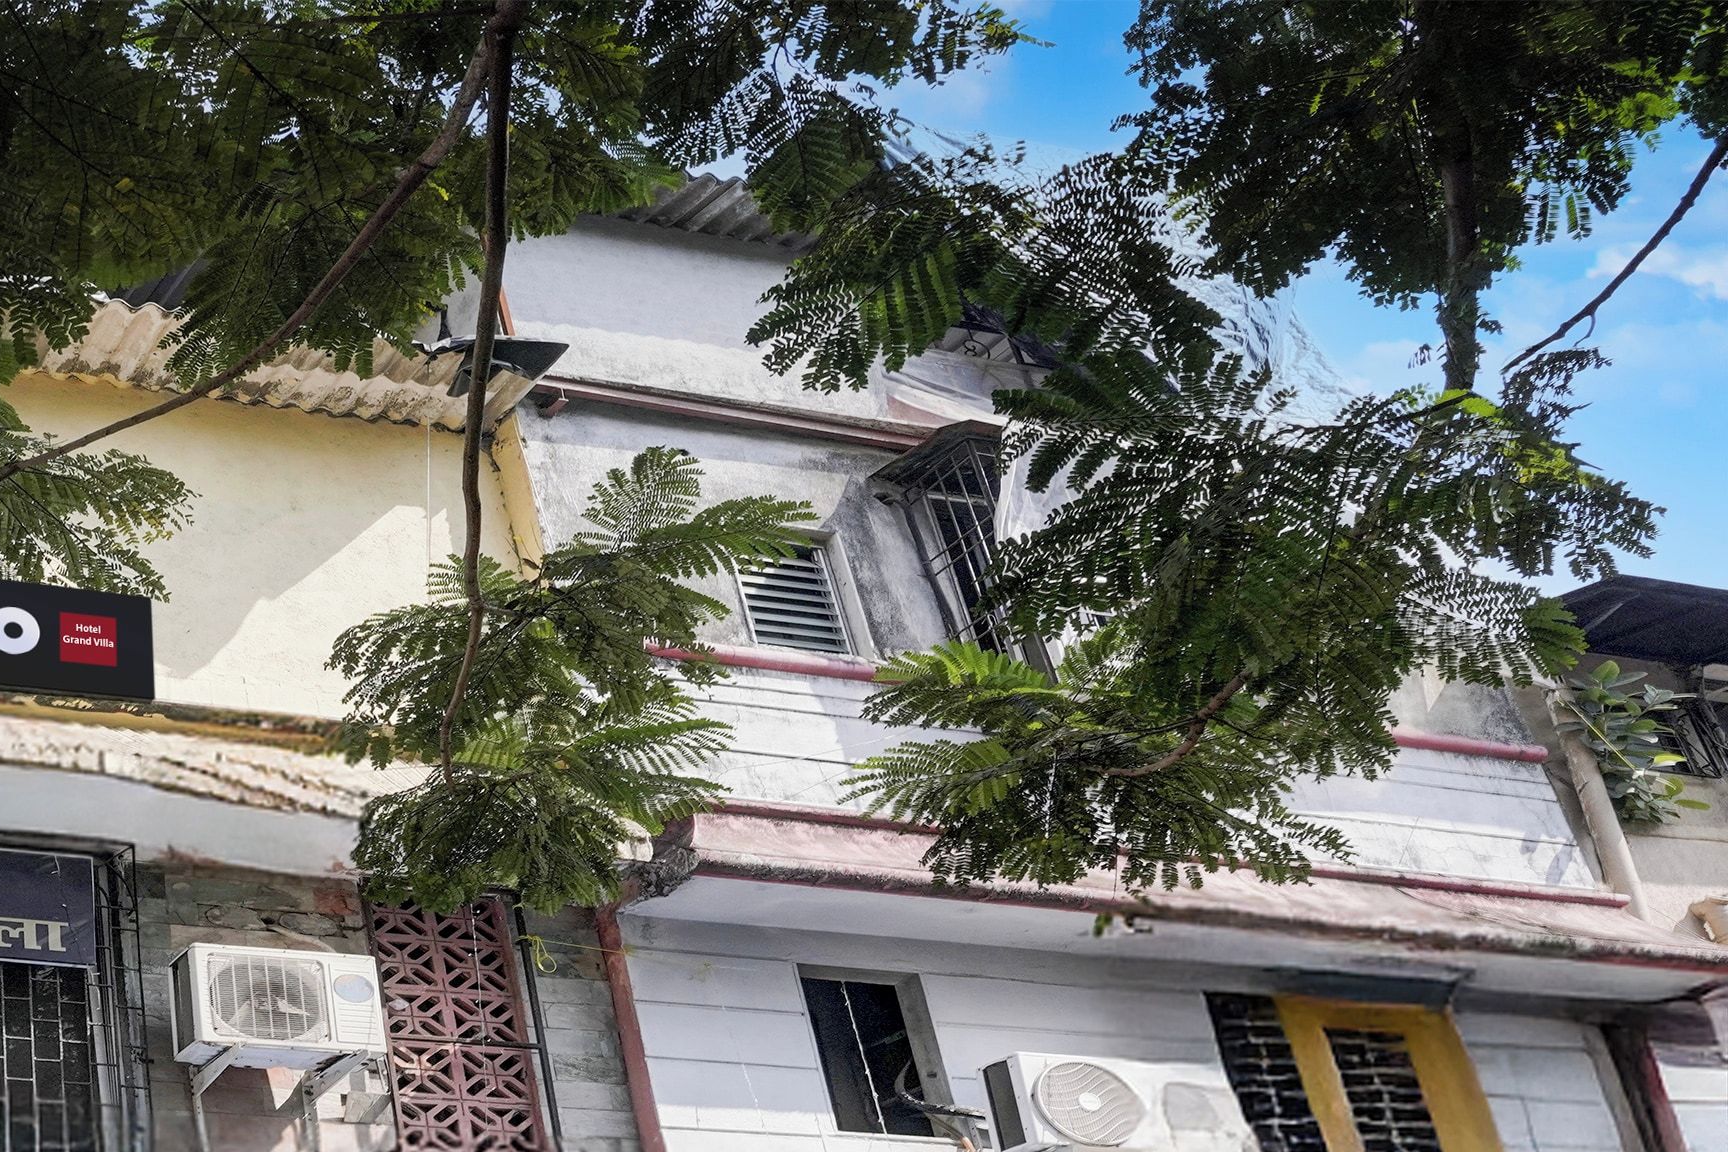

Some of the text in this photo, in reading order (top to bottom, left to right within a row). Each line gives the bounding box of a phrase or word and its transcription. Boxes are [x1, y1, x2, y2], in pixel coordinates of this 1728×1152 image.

[75, 623, 101, 635] Hotel
[62, 634, 114, 648] Grand Villa
